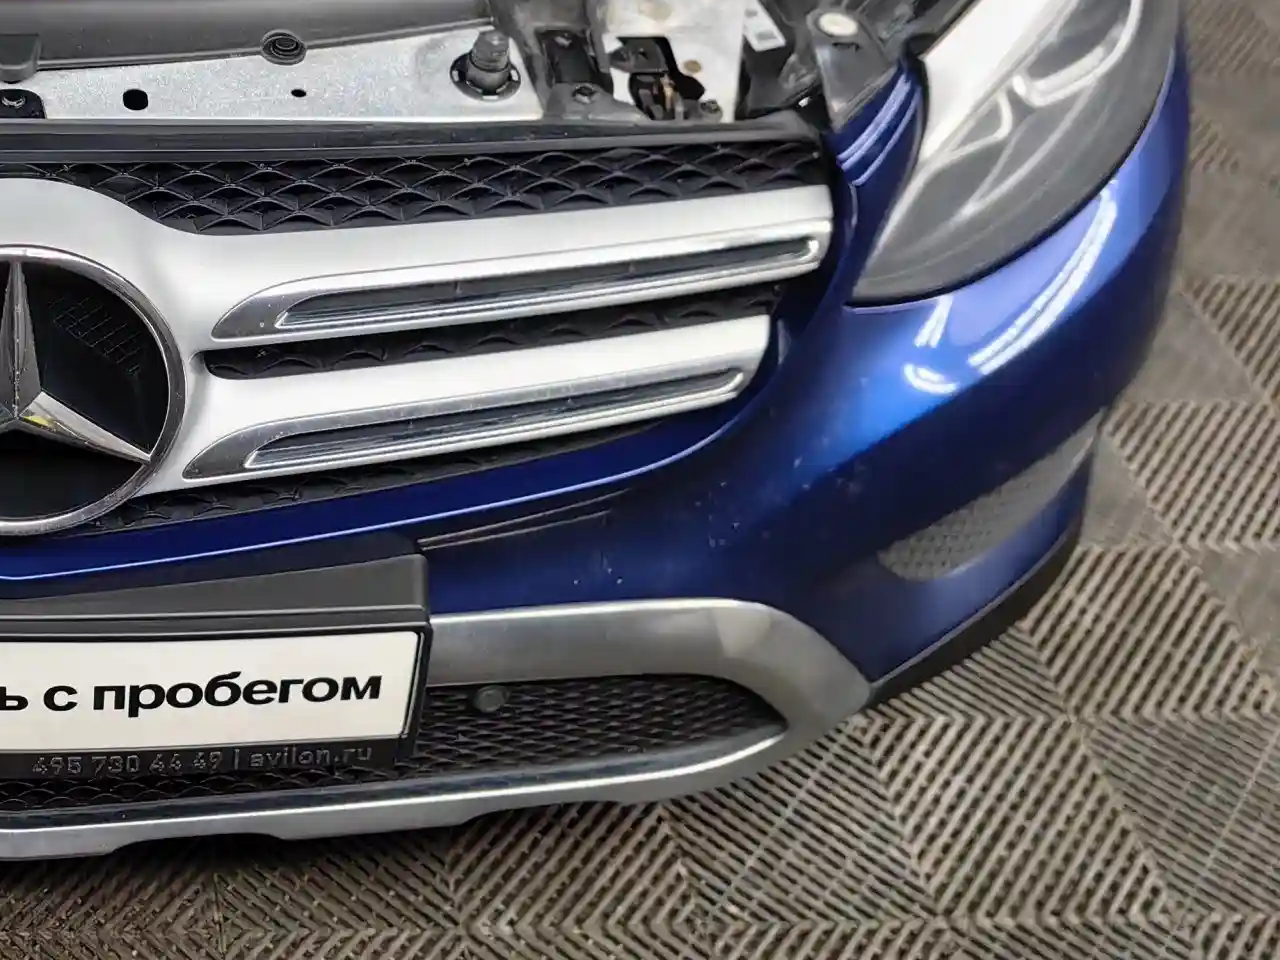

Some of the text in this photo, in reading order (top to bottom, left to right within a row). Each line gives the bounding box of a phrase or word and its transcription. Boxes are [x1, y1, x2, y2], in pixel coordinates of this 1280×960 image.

[43, 685, 78, 711] с
[93, 671, 382, 718] пробегом
[32, 757, 82, 775] 495
[91, 755, 140, 773] 730
[149, 753, 183, 773] 44
[247, 746, 372, 769] avilon.ru
